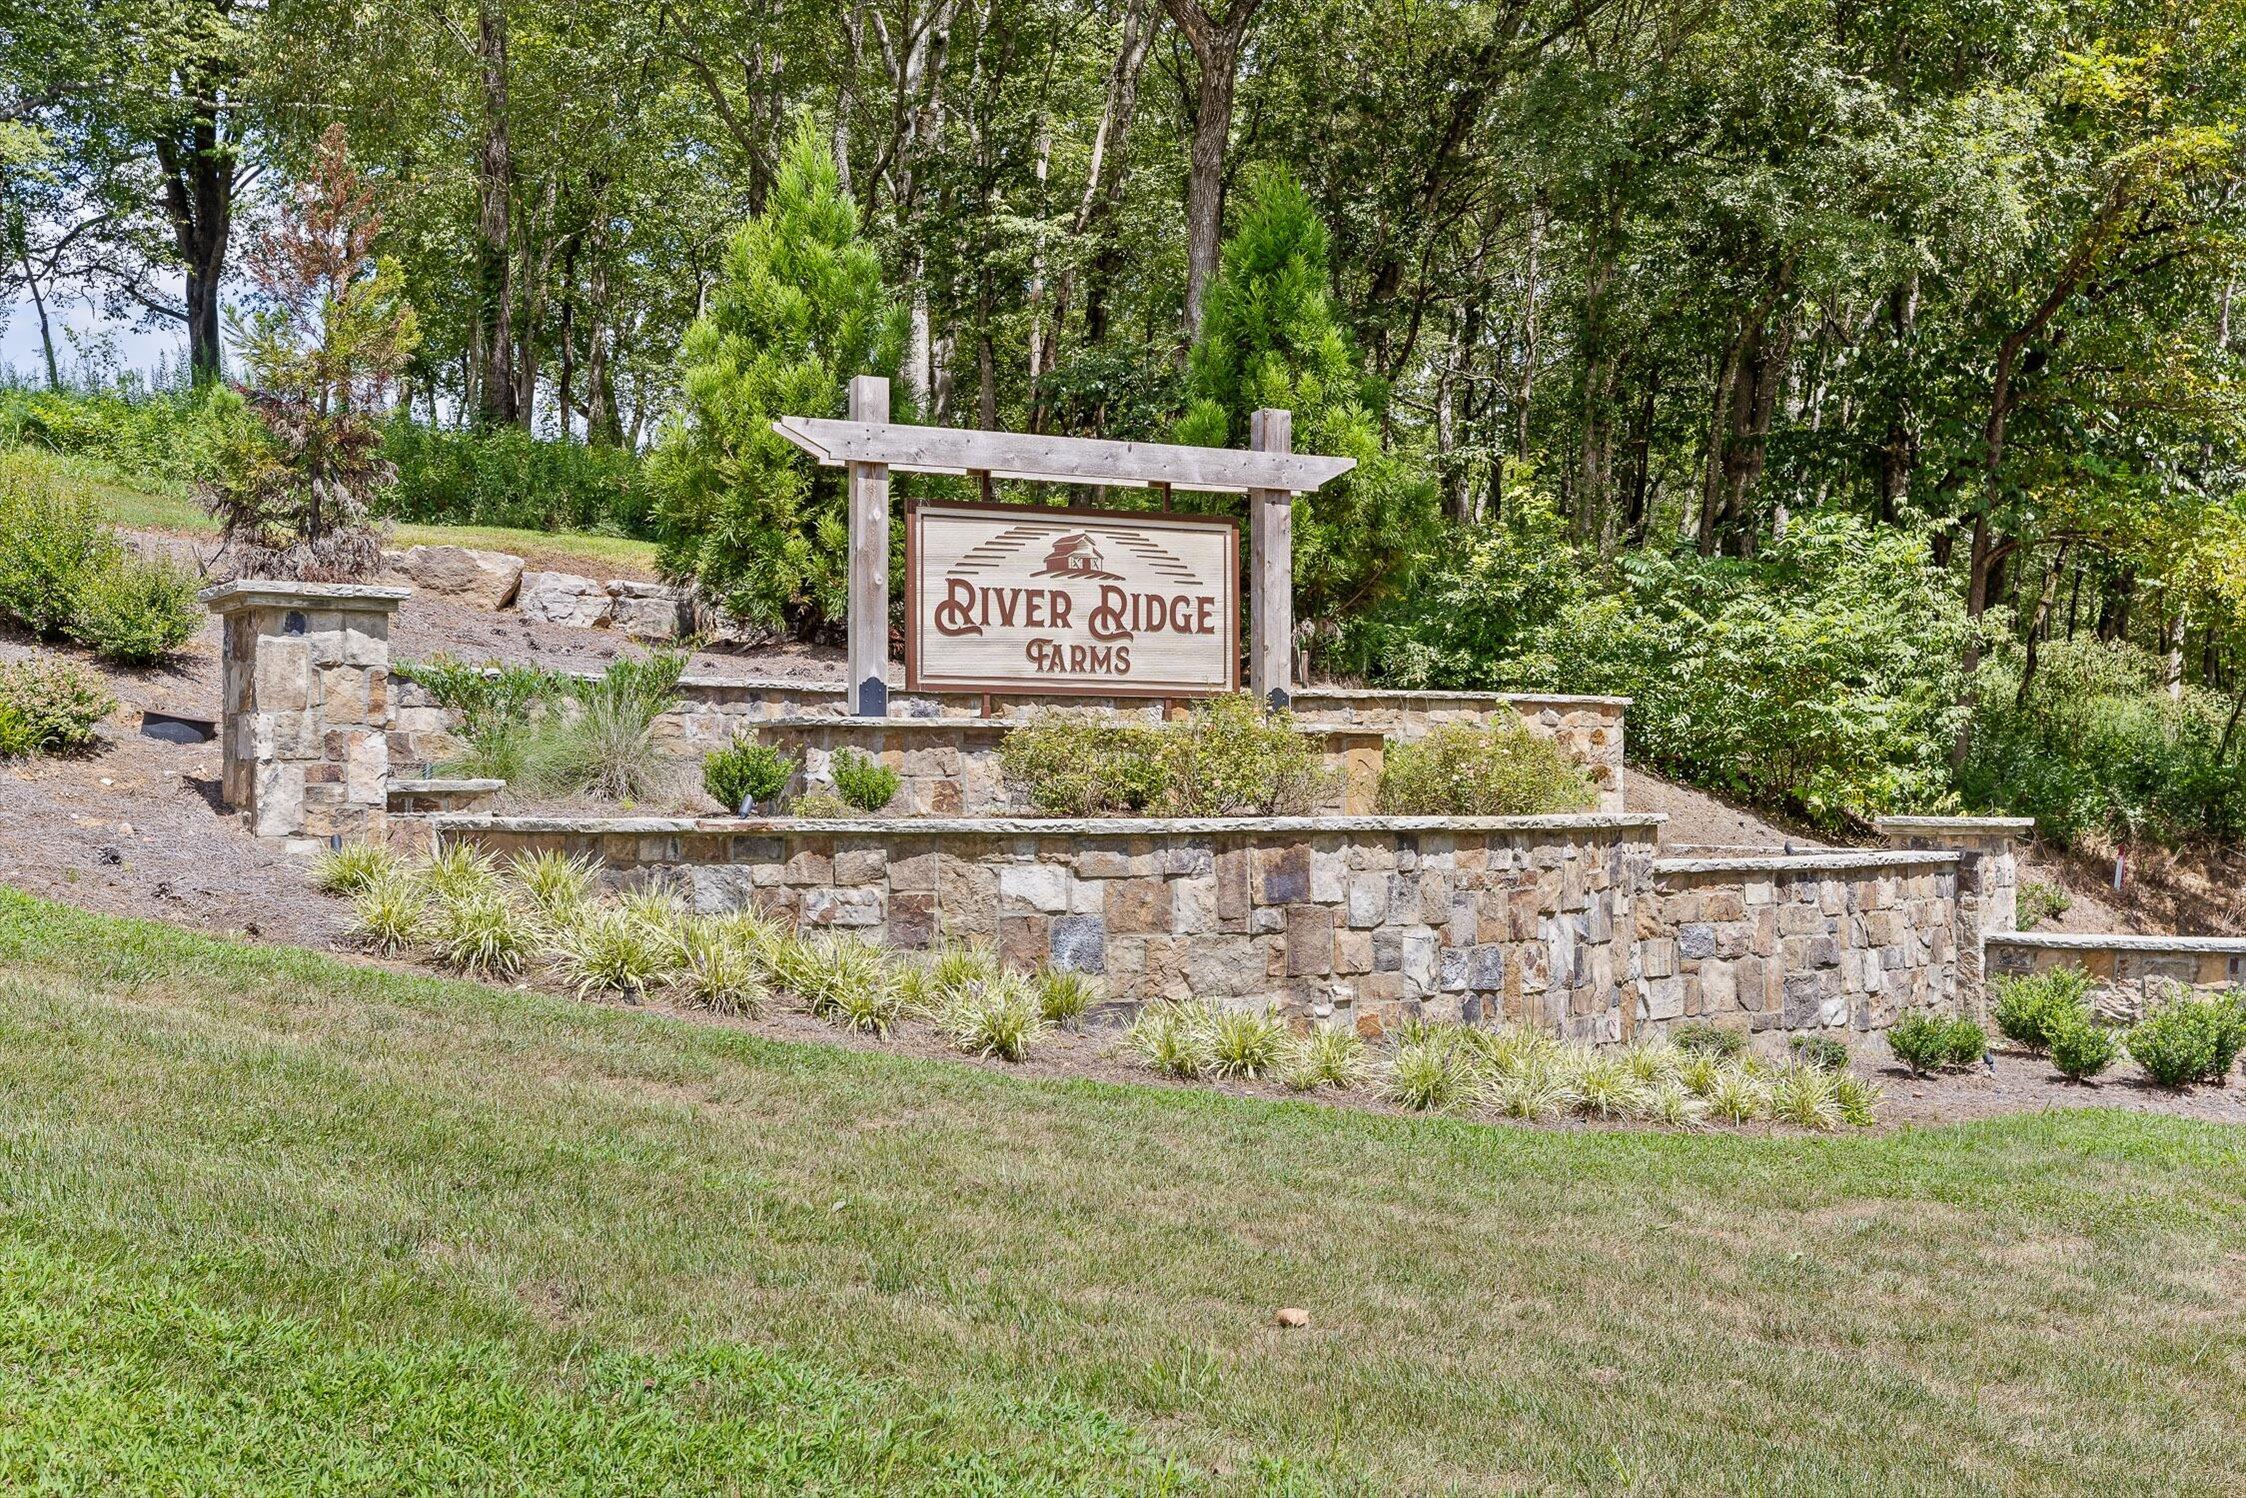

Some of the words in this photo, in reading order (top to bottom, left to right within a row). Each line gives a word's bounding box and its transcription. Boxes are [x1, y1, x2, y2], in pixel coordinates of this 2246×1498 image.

[934, 577, 1073, 637] RIVER
[1088, 584, 1215, 642] RIDGE
[1025, 638, 1131, 675] FARMS
